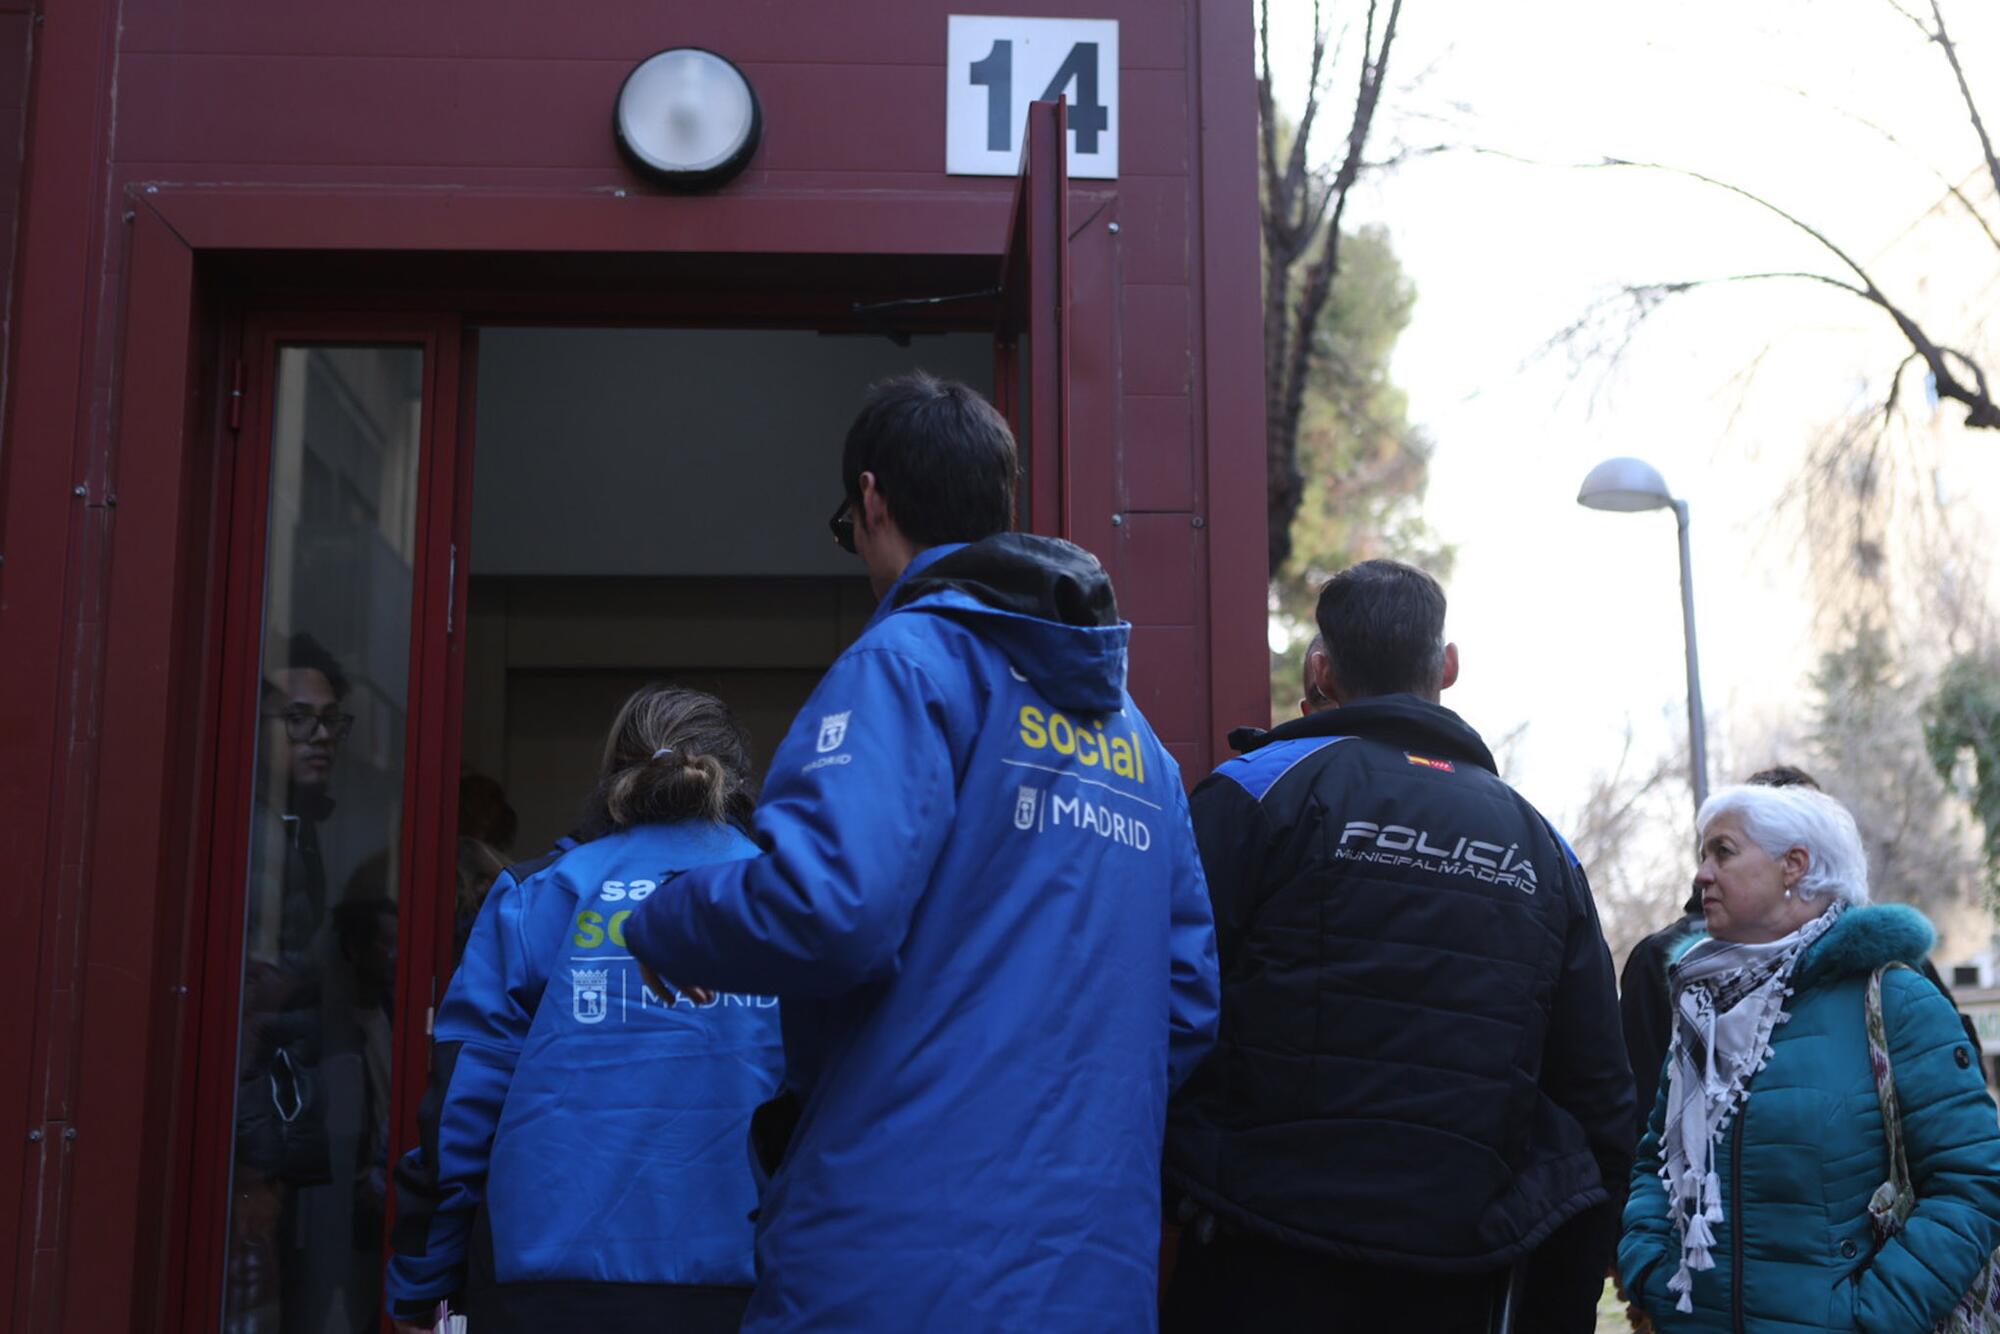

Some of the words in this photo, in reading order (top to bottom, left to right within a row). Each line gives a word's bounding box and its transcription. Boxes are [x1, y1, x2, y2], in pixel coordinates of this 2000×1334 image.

[970, 40, 1108, 154] 14
[1019, 705, 1144, 784] social
[1052, 795, 1150, 851] MADRID
[1340, 821, 1538, 883] POLICÍA
